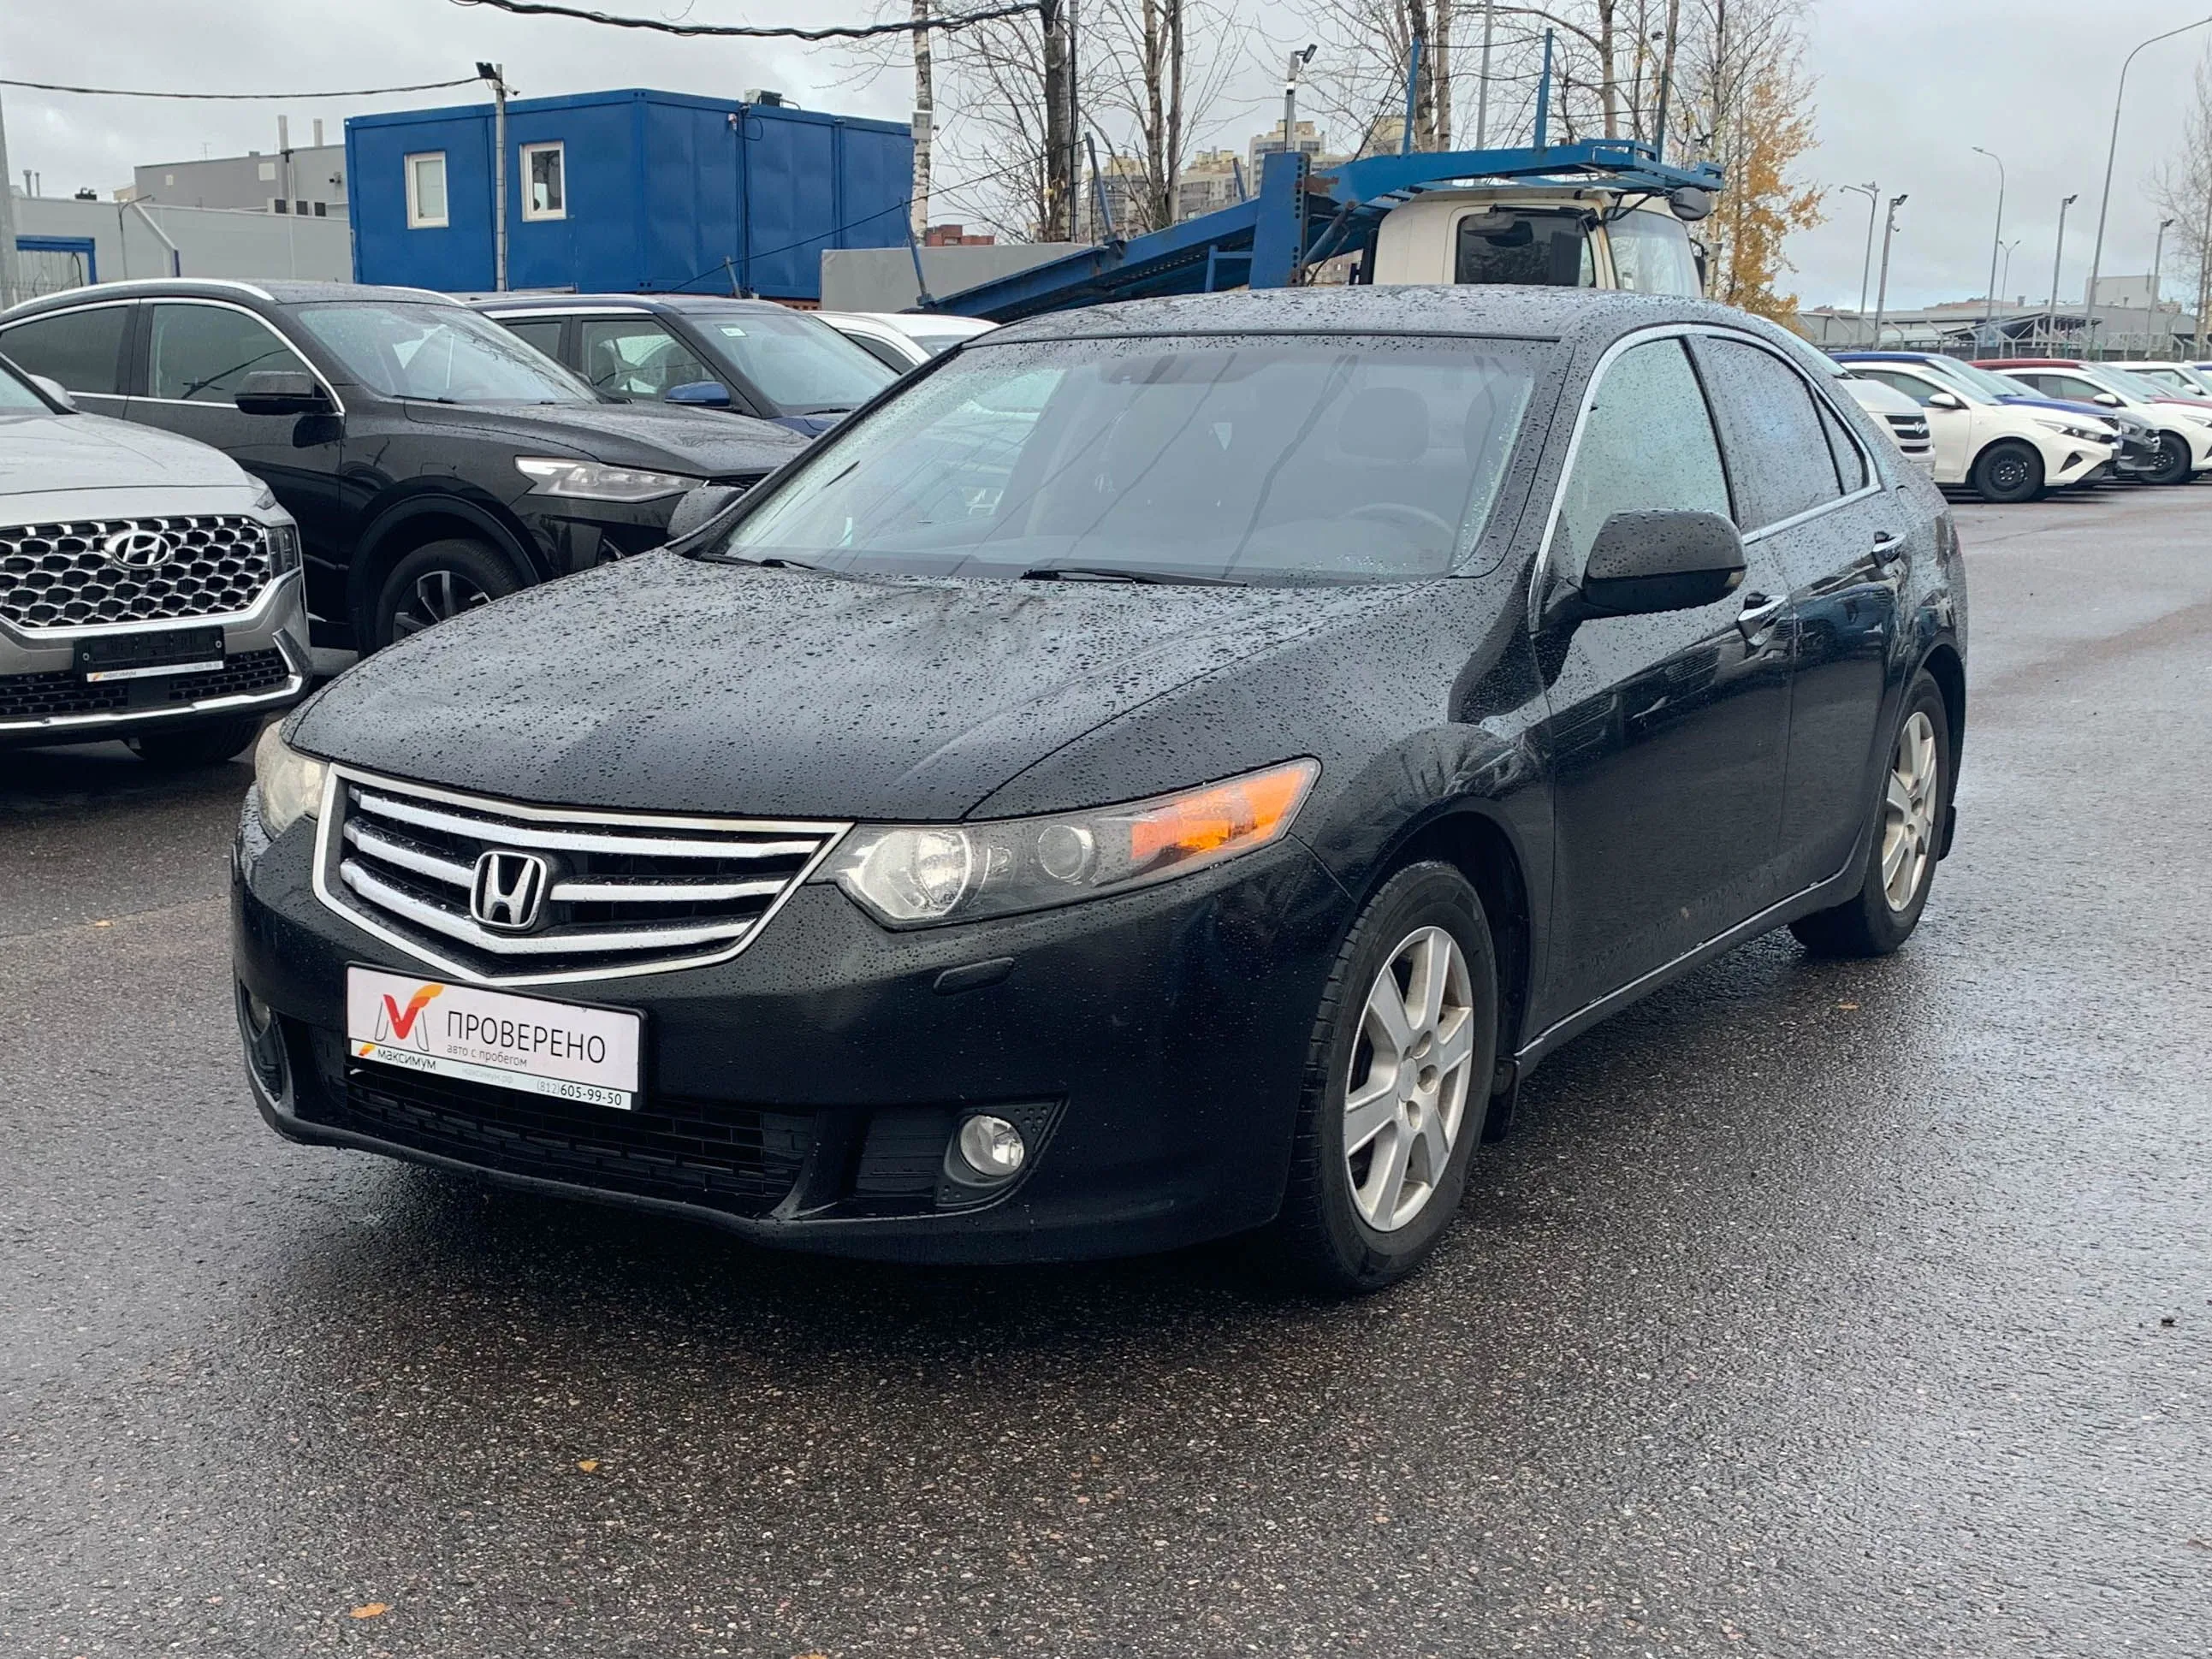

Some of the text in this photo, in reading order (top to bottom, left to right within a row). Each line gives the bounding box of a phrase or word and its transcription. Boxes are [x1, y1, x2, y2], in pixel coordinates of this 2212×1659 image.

[446, 1010, 606, 1064] ПРОВЕРЕНО
[377, 1048, 436, 1070] максимум
[447, 1044, 527, 1068] авто с пробегом
